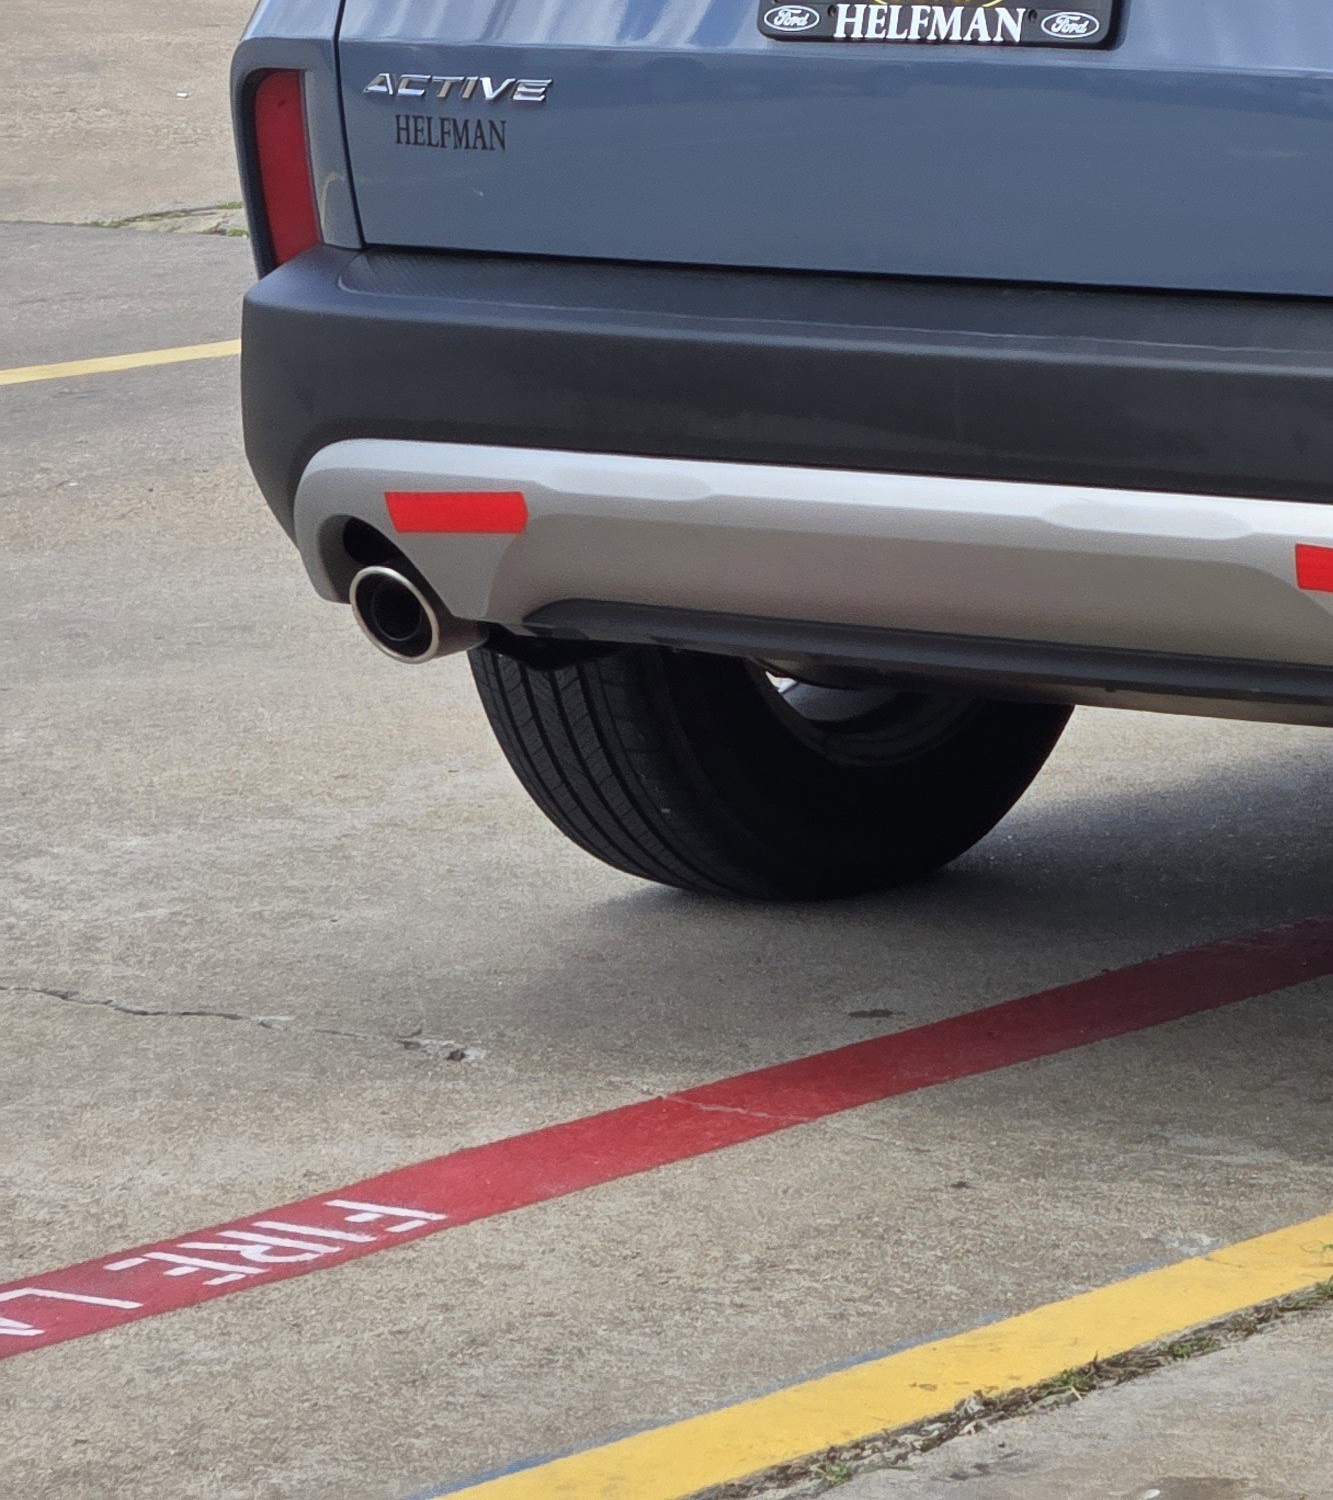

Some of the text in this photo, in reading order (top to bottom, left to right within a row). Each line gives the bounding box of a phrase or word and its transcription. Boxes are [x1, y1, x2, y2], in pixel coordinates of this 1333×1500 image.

[833, 3, 1026, 44] HELFMAN
[363, 72, 553, 102] ACTIVE
[394, 114, 507, 151] HELFMAN
[104, 1198, 447, 1286] FIRE
